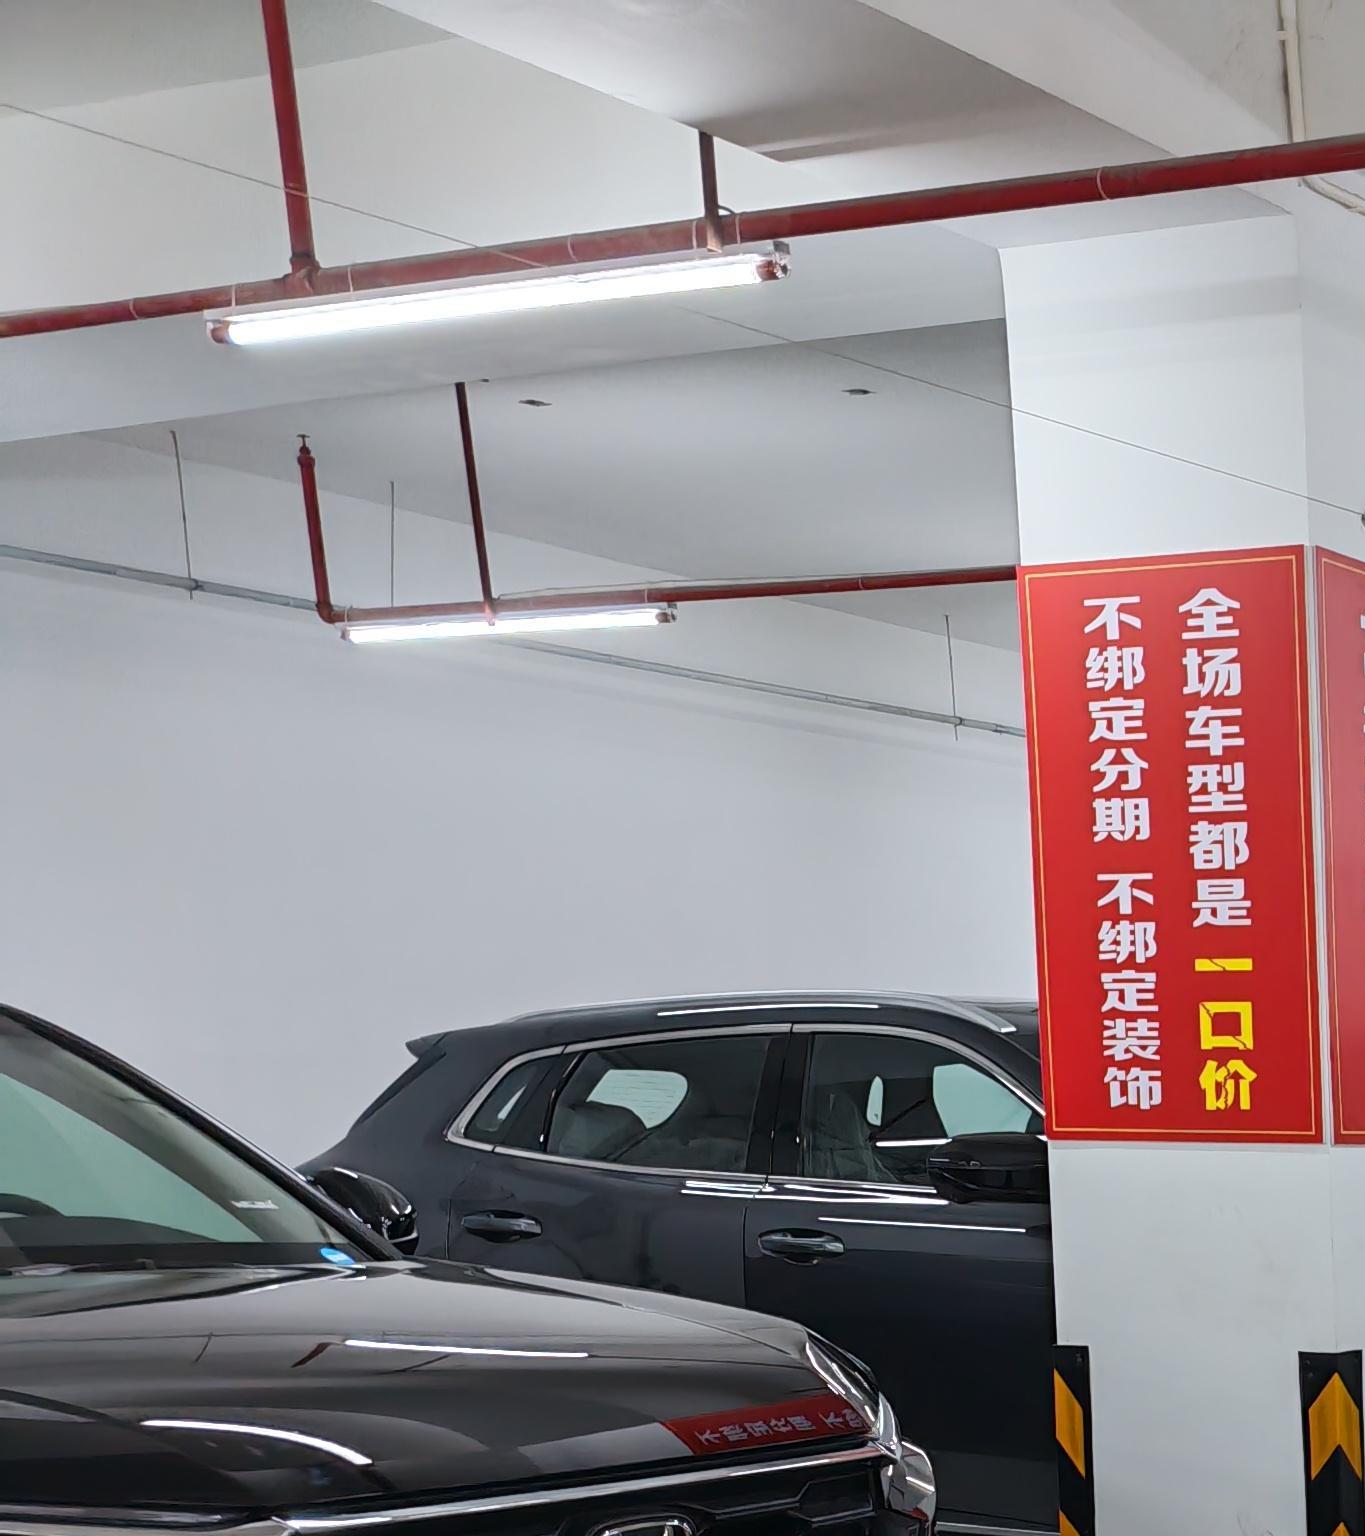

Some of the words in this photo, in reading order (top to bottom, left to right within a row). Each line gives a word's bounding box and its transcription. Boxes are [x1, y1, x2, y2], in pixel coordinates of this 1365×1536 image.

[1083, 595, 1151, 843] 不绑定分期
[1178, 587, 1259, 1112] 全场车型都是一口价
[1096, 872, 1163, 1111] 不绑定装饰
